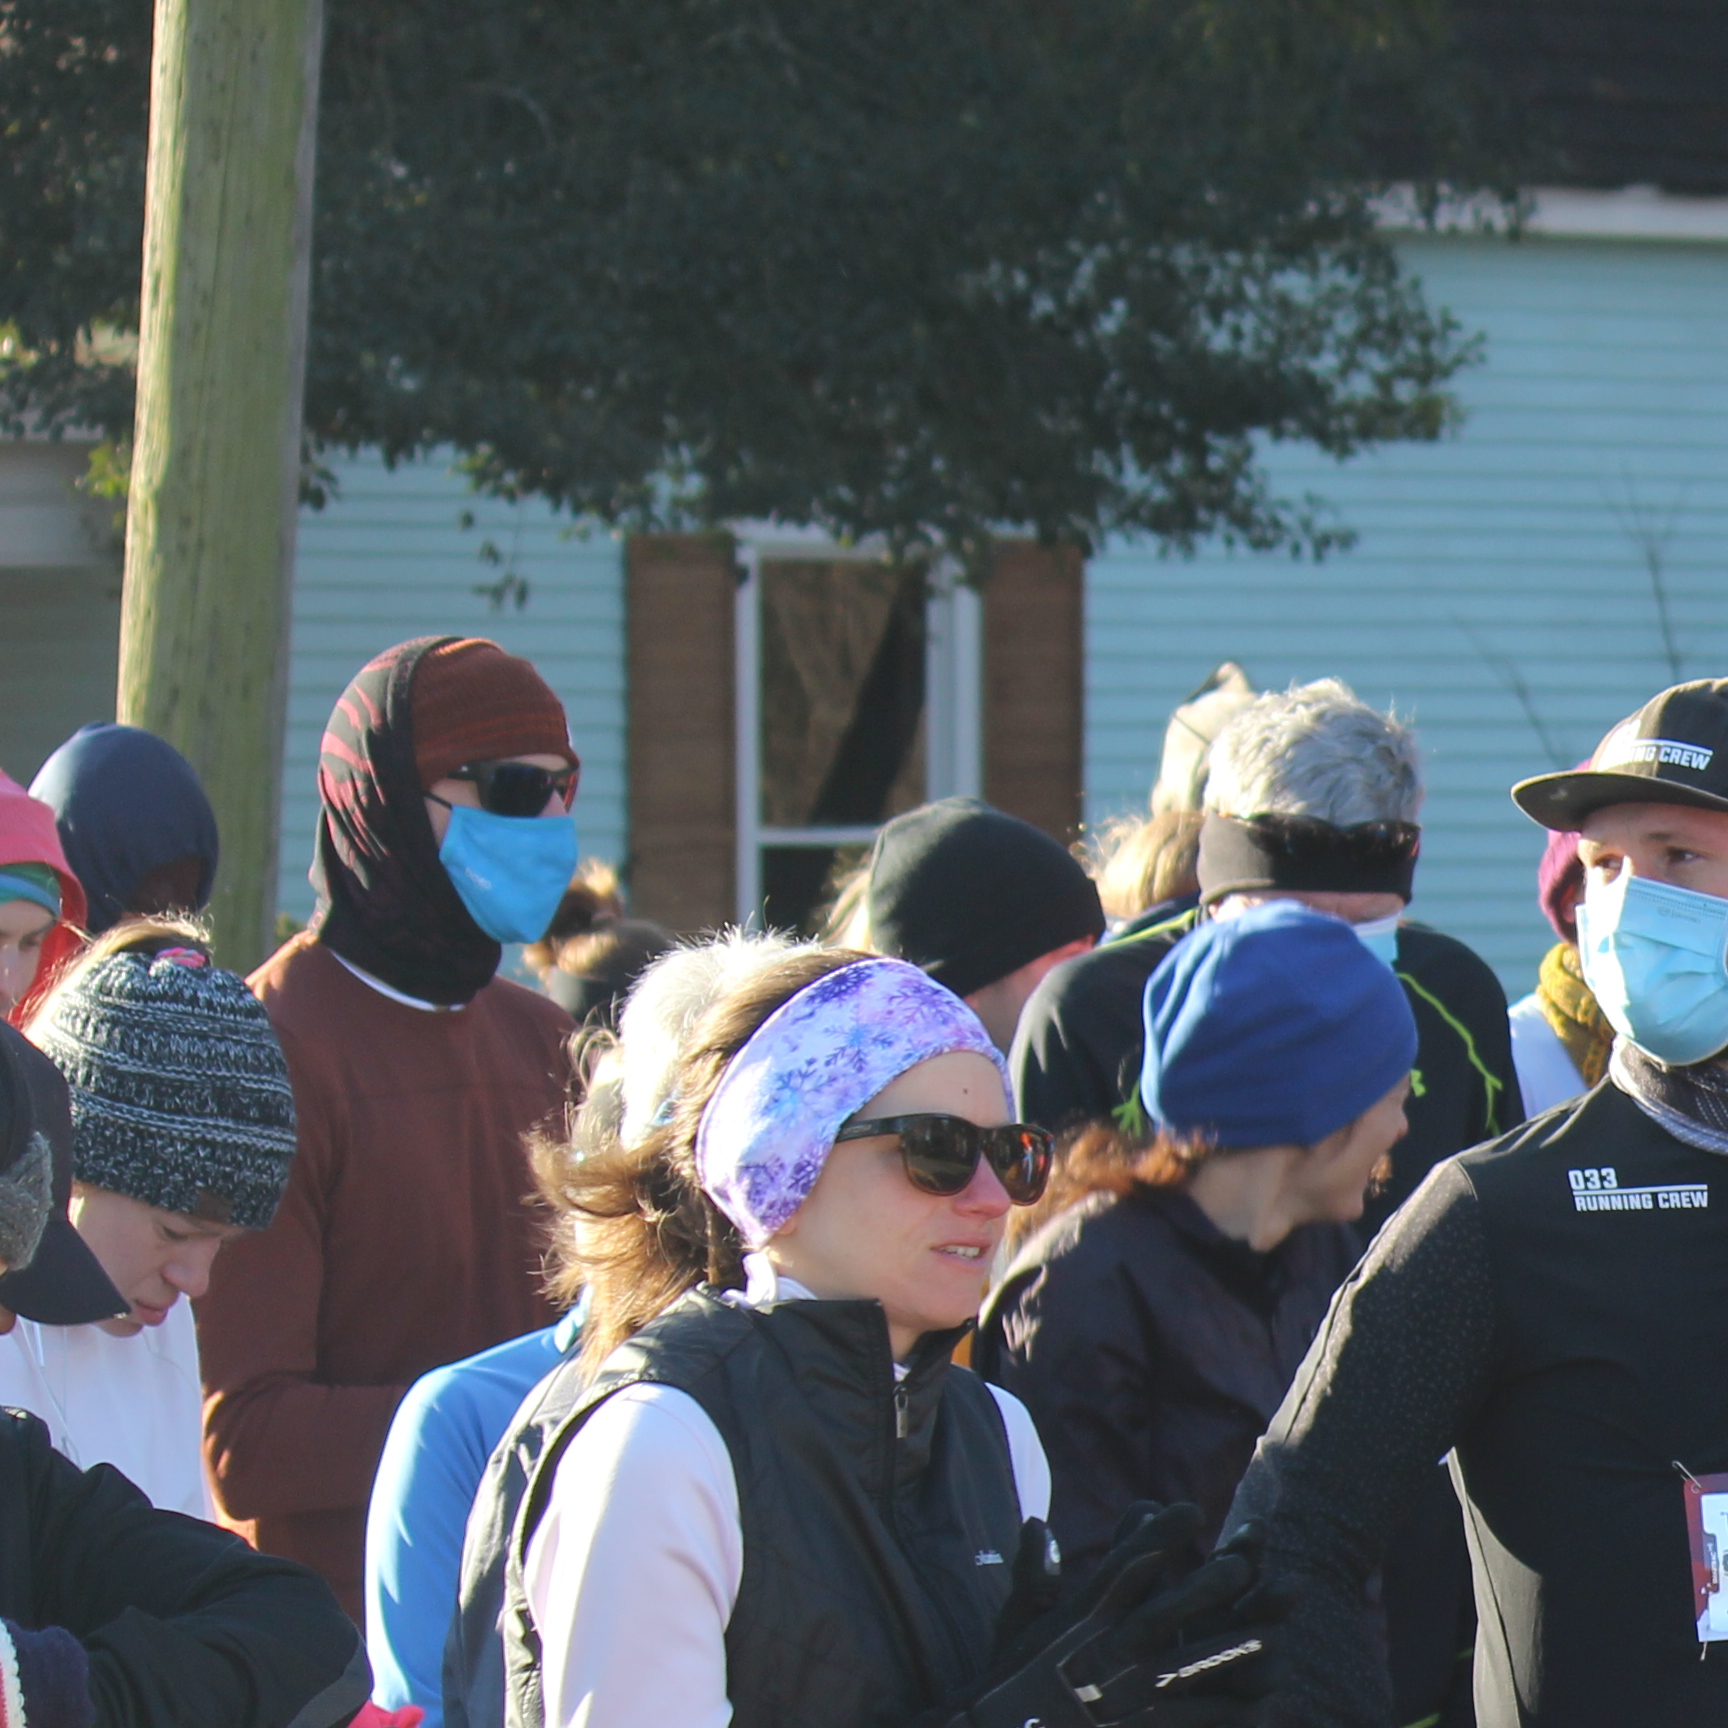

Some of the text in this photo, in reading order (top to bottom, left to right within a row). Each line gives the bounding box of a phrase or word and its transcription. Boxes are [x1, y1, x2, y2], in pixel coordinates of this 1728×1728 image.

[1658, 745, 1711, 771] CREW
[1567, 1167, 1618, 1191] 033
[1574, 1191, 1708, 1212] RUNNING CREW
